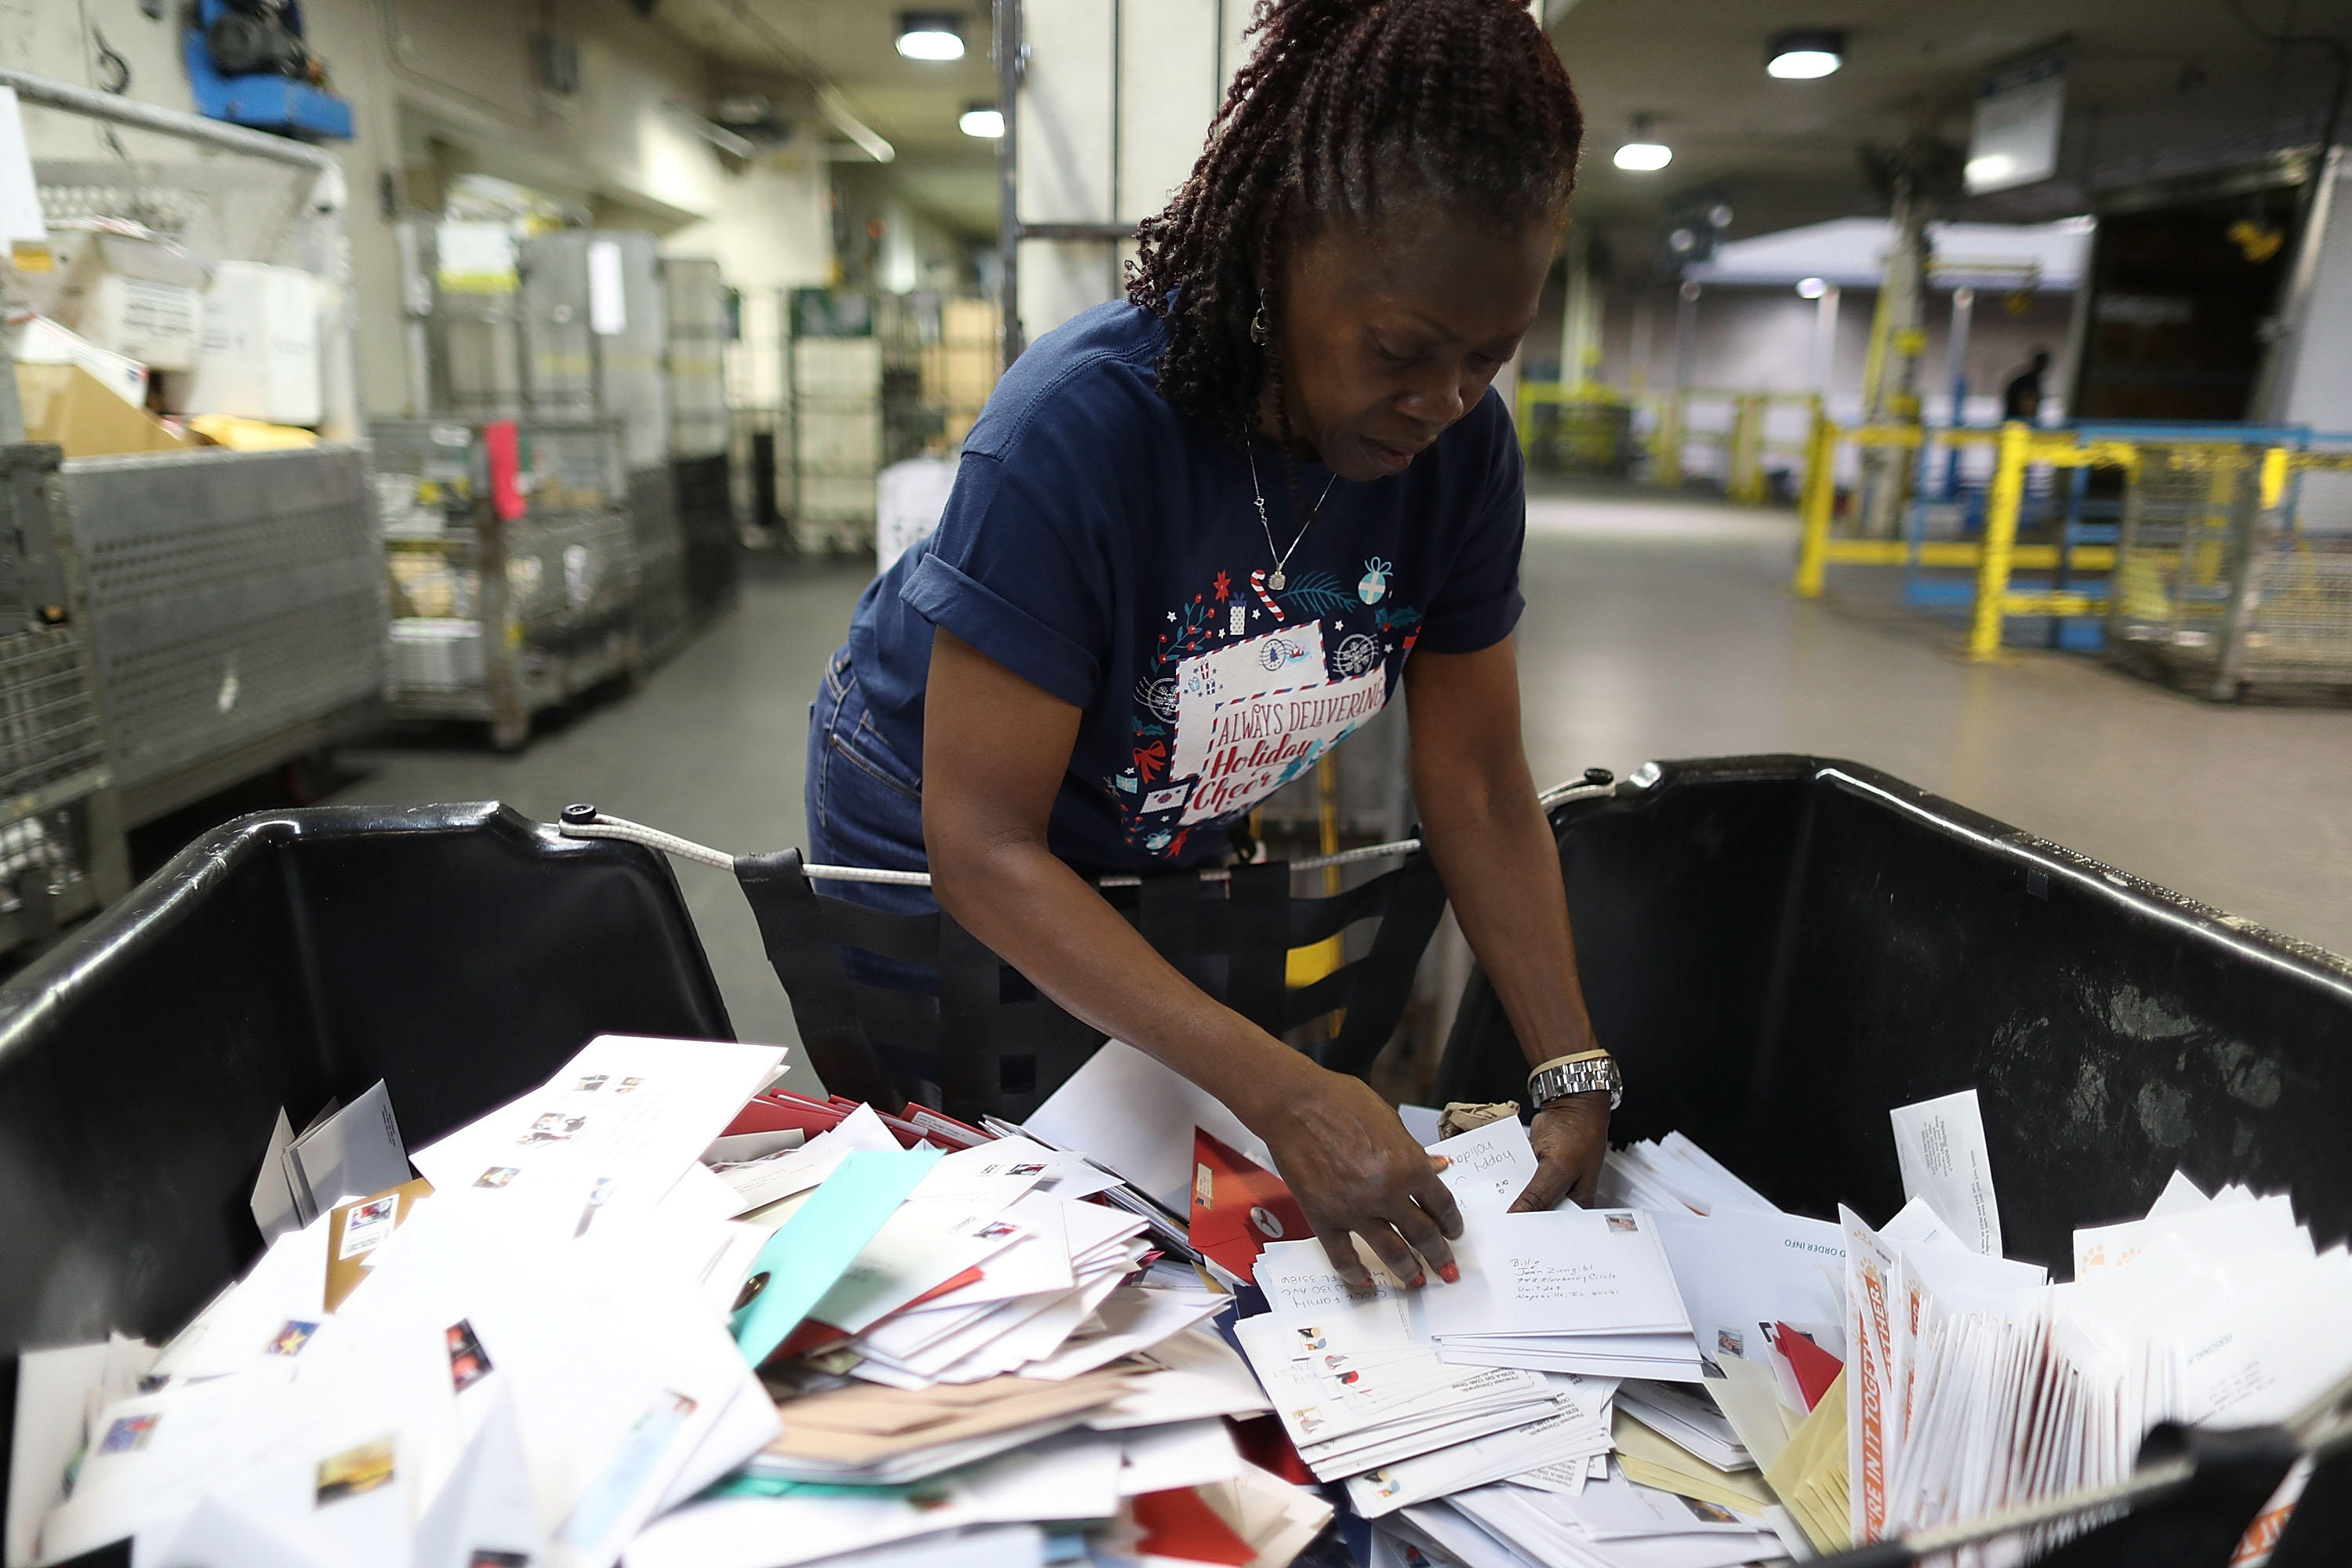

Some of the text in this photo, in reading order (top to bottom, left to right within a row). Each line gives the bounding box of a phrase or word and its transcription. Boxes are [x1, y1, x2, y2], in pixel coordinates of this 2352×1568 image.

[1218, 681, 1385, 747] ALWAYS DELIVERING
[1210, 733, 1312, 779] Holiday
[1192, 771, 1272, 811] Cheer
[1473, 1149, 1516, 1173] happy
[1784, 1238, 1806, 1250] INFO
[1806, 1241, 1838, 1256] ORDER
[1865, 1424, 1880, 1455] IT
[1866, 1452, 1882, 1486] IN
